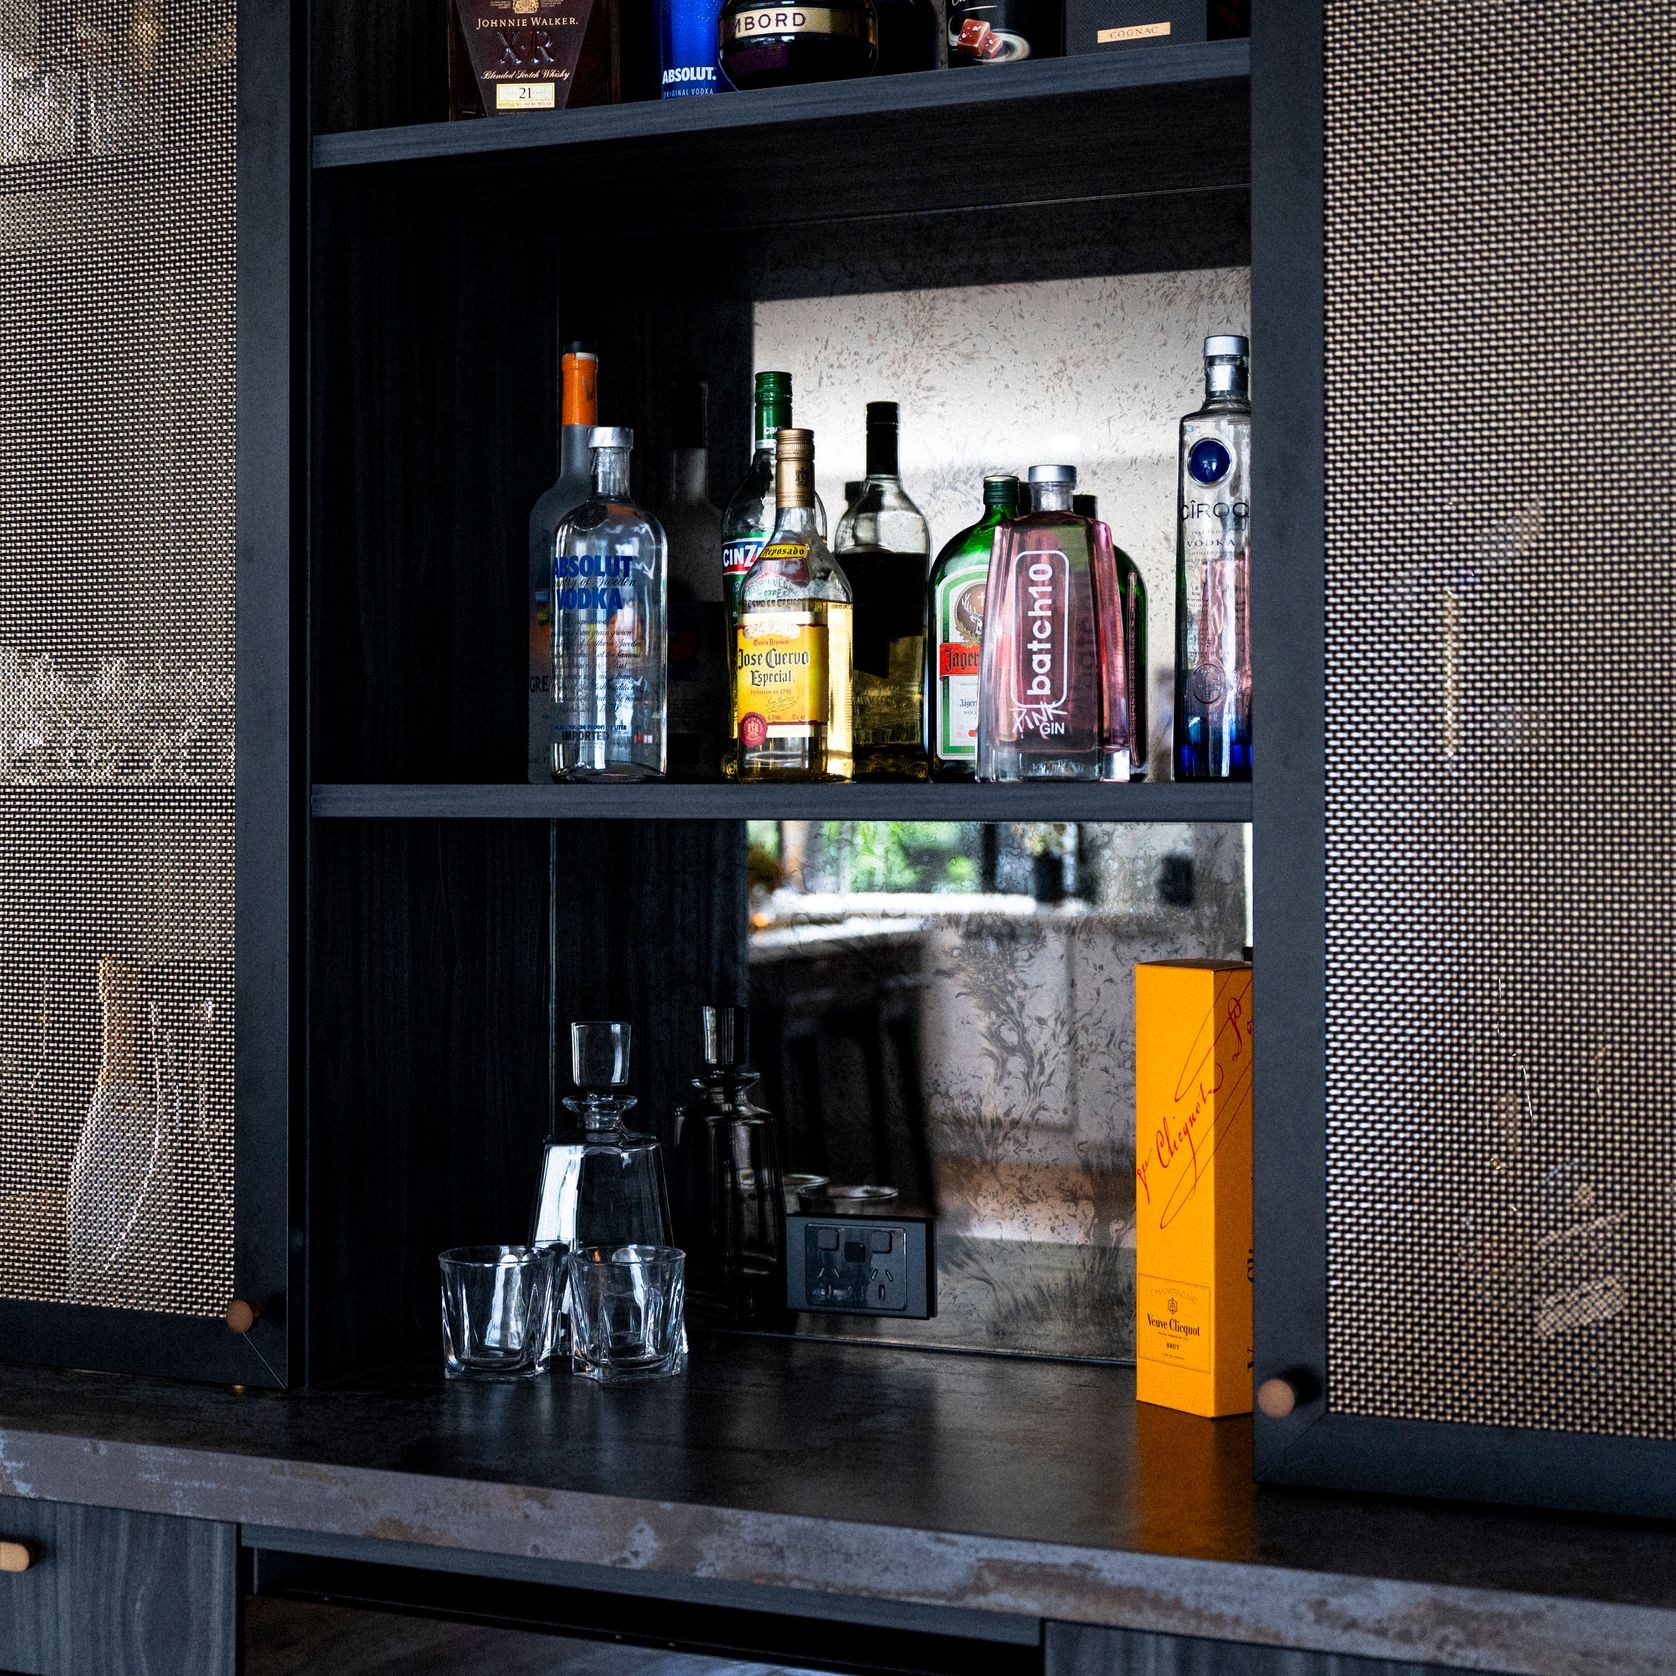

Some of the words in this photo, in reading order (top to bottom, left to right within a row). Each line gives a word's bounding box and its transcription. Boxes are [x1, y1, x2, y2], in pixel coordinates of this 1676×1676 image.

[476, 18, 527, 30] JOHNNIE
[1109, 26, 1159, 39] COGNAC
[481, 70, 515, 79] Blended
[514, 70, 540, 79] Scotch
[540, 69, 570, 80] Whisky
[519, 87, 532, 99] 21
[690, 88, 714, 96] VODKA
[1186, 539, 1235, 548] VODKA
[763, 546, 805, 557] Reposado
[553, 555, 633, 578] ABSOLUT
[556, 587, 624, 610] VODKA
[1026, 563, 1053, 696] batch10
[738, 648, 763, 670] Jose
[765, 648, 809, 668] Cuervo
[750, 670, 793, 687] Especial
[1040, 722, 1065, 735] GIN
[562, 731, 609, 742] IMPORTED
[1146, 1313, 1169, 1330] Veuve
[1169, 1318, 1201, 1337] Clicquot
